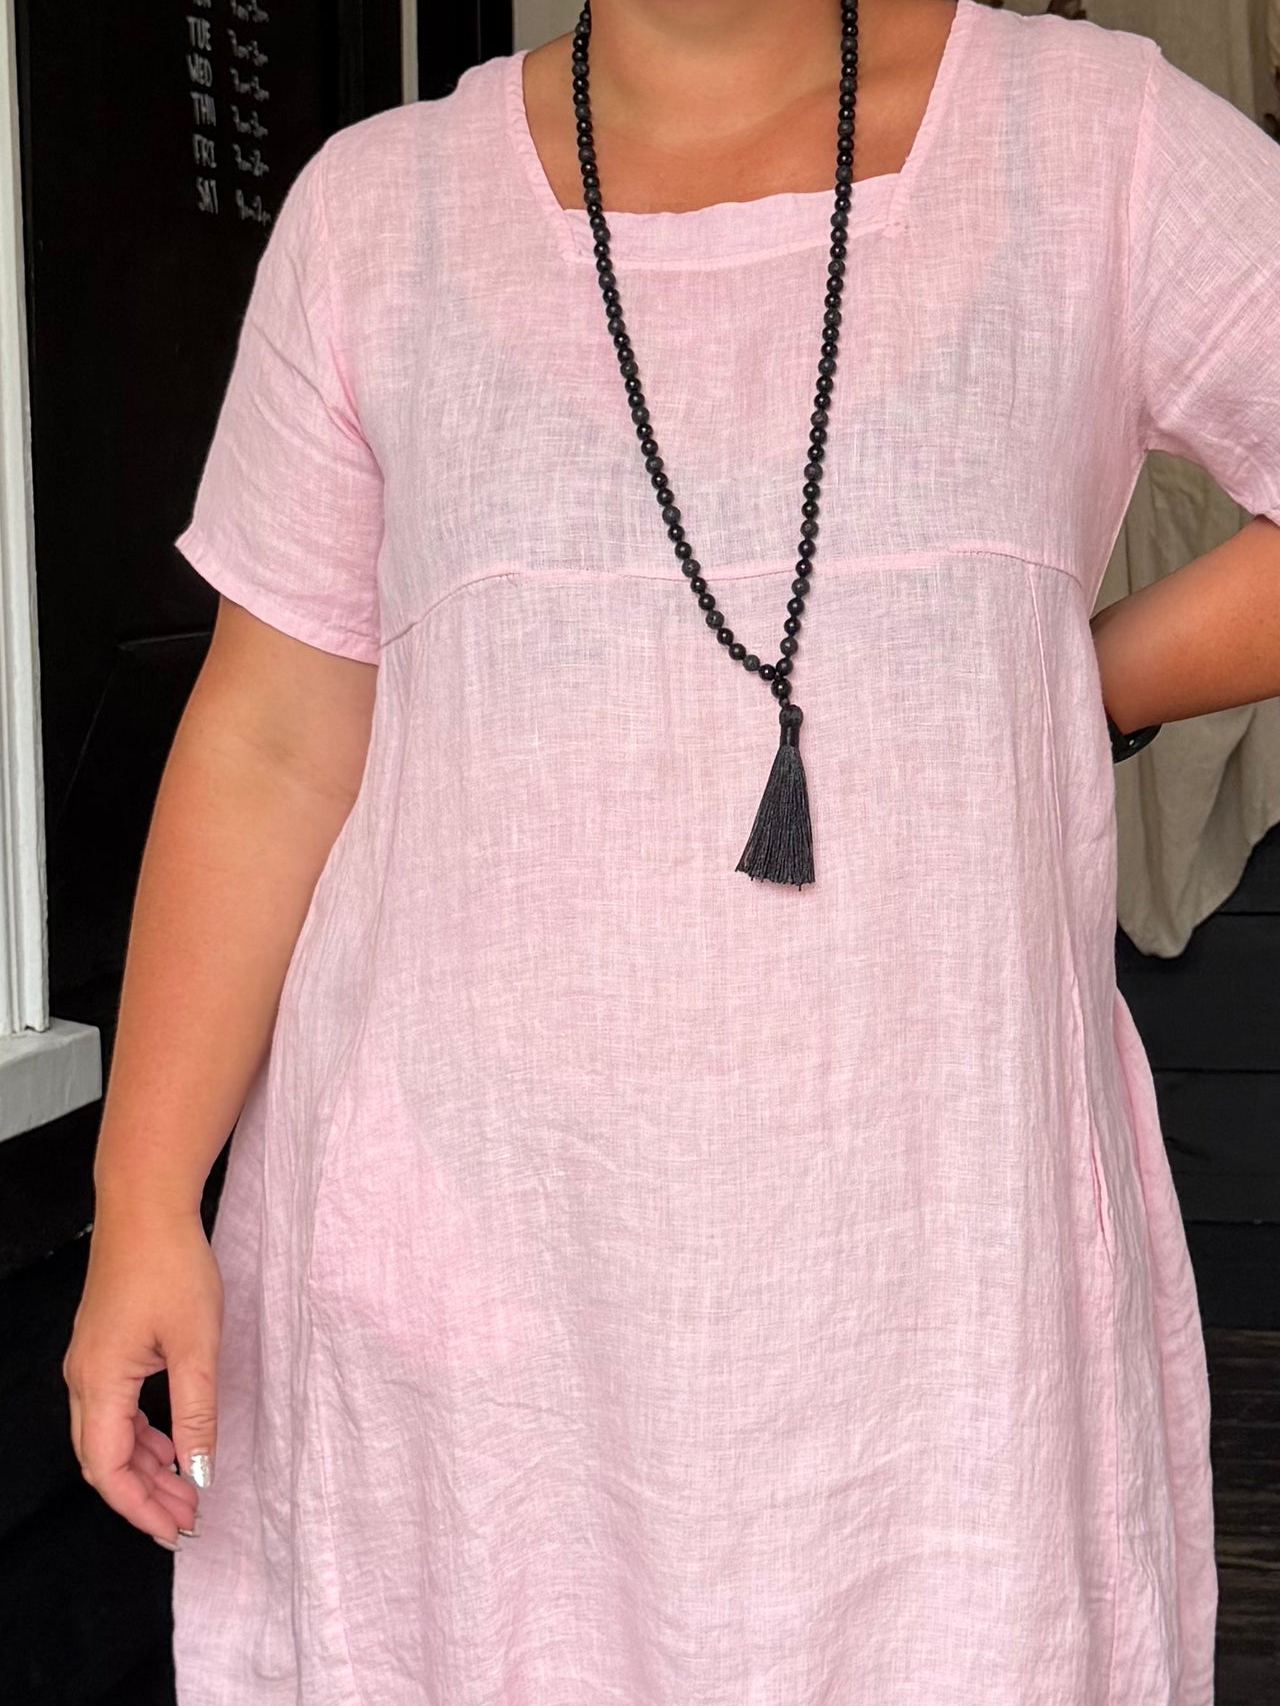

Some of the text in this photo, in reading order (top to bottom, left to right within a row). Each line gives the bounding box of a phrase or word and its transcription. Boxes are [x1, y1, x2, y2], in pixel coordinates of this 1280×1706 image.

[186, 15, 211, 51] TUE
[185, 53, 212, 88] WED
[190, 91, 216, 127] THU
[193, 133, 217, 169] FRI
[196, 176, 218, 214] SAT
